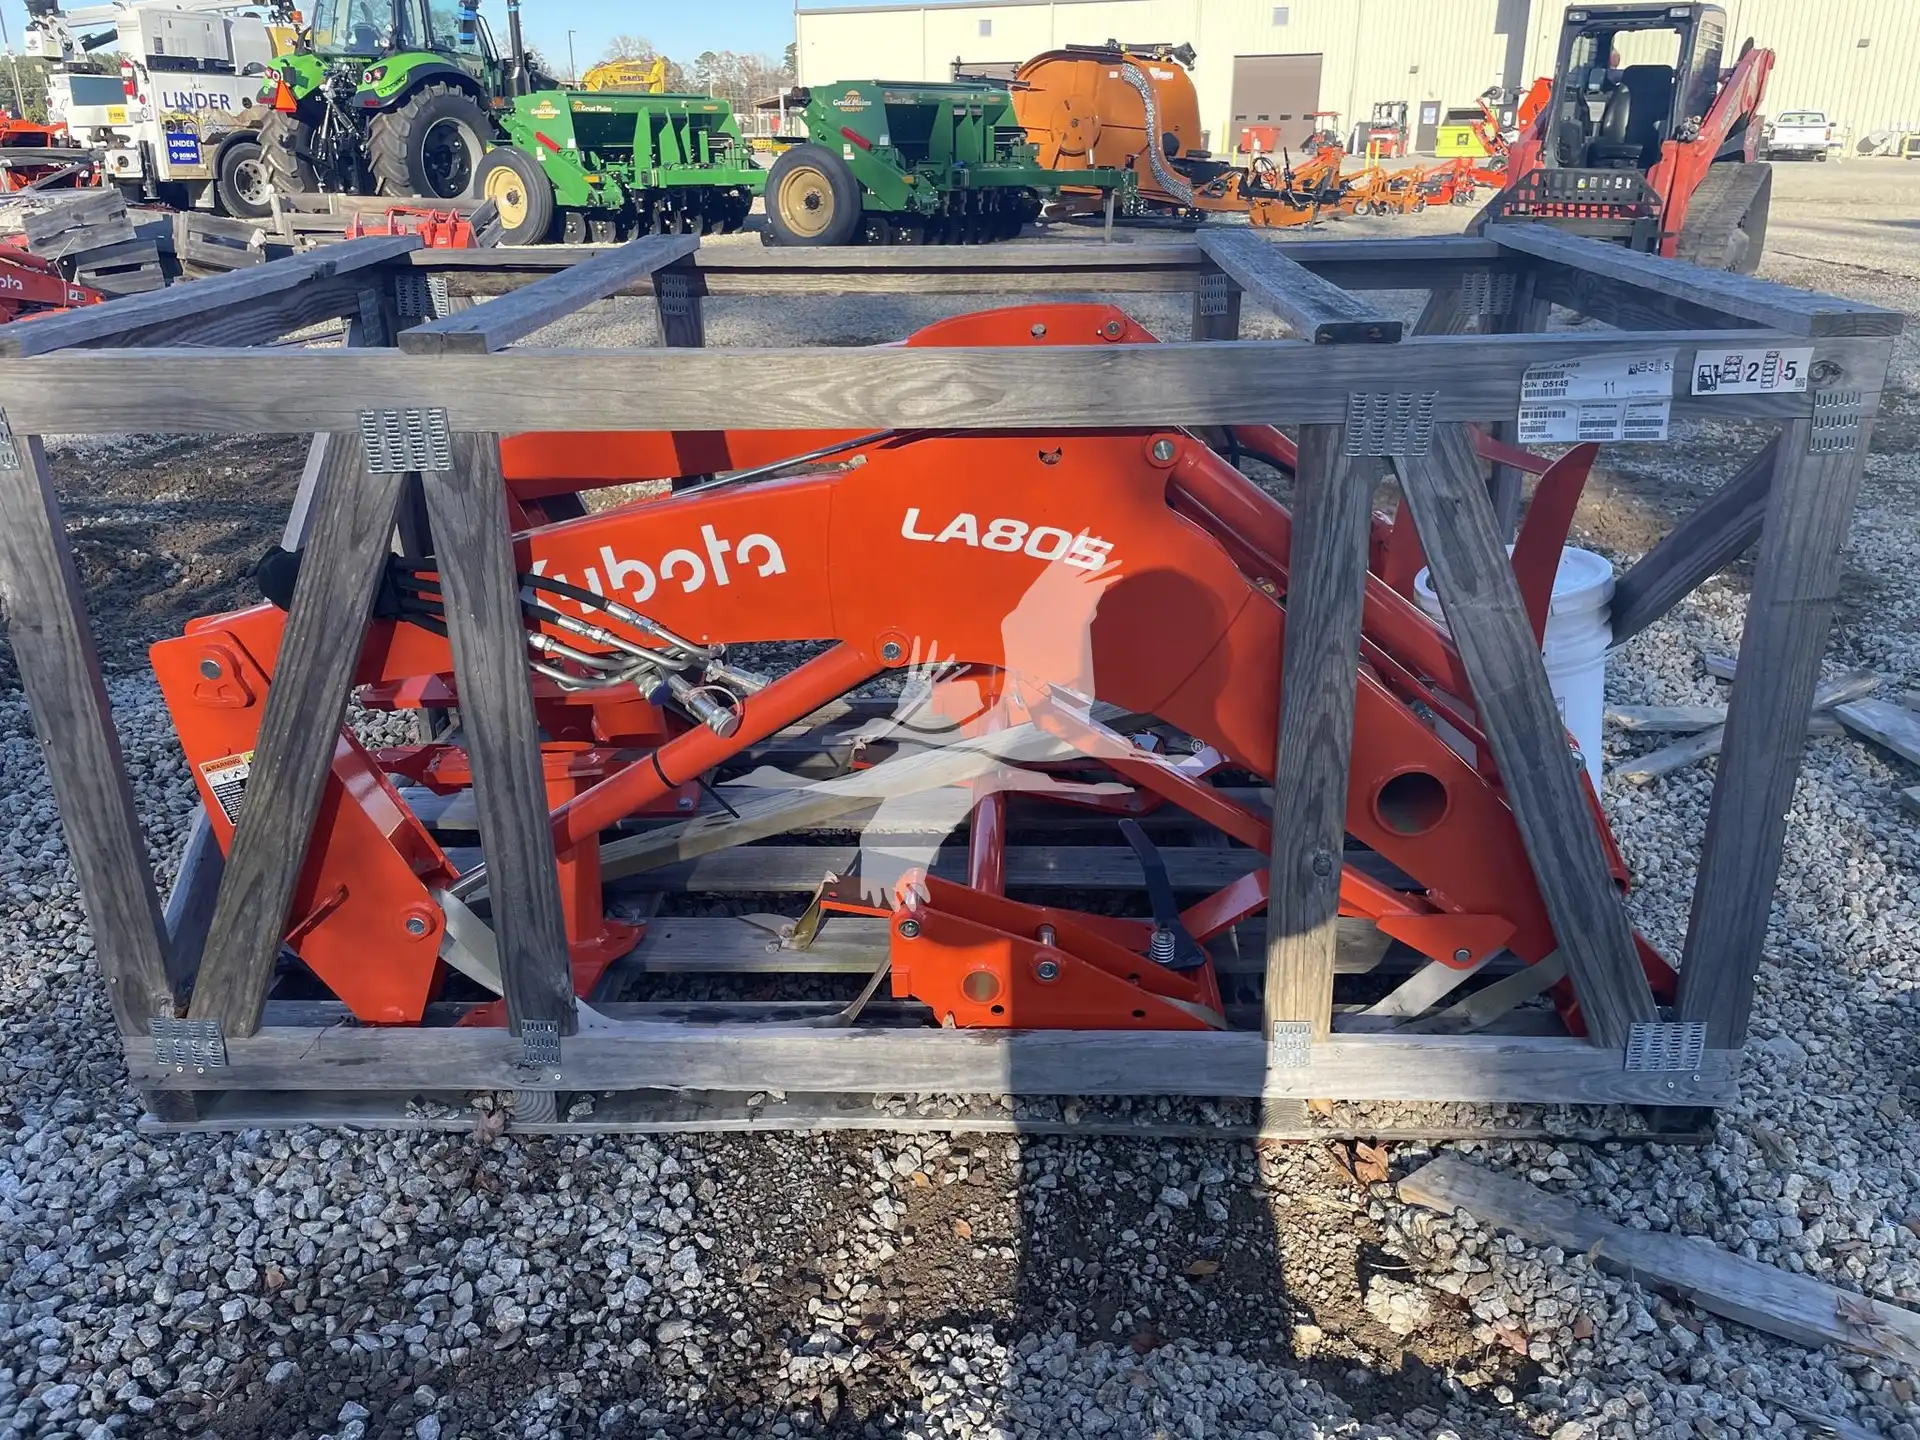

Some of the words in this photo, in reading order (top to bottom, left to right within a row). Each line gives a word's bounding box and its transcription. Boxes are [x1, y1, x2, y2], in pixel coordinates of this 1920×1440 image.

[162, 91, 232, 111] LINDER
[581, 105, 597, 113] Great
[597, 105, 613, 113] Plains
[169, 140, 196, 148] LINDER
[1664, 361, 1671, 371] 5
[1746, 362, 1760, 382] 2
[1783, 360, 1798, 381] 5
[1524, 381, 1538, 389] S/N
[1542, 379, 1569, 388] D5149
[1603, 380, 1615, 395] 11
[901, 507, 1115, 571] LA805
[211, 757, 241, 770] WARNING
